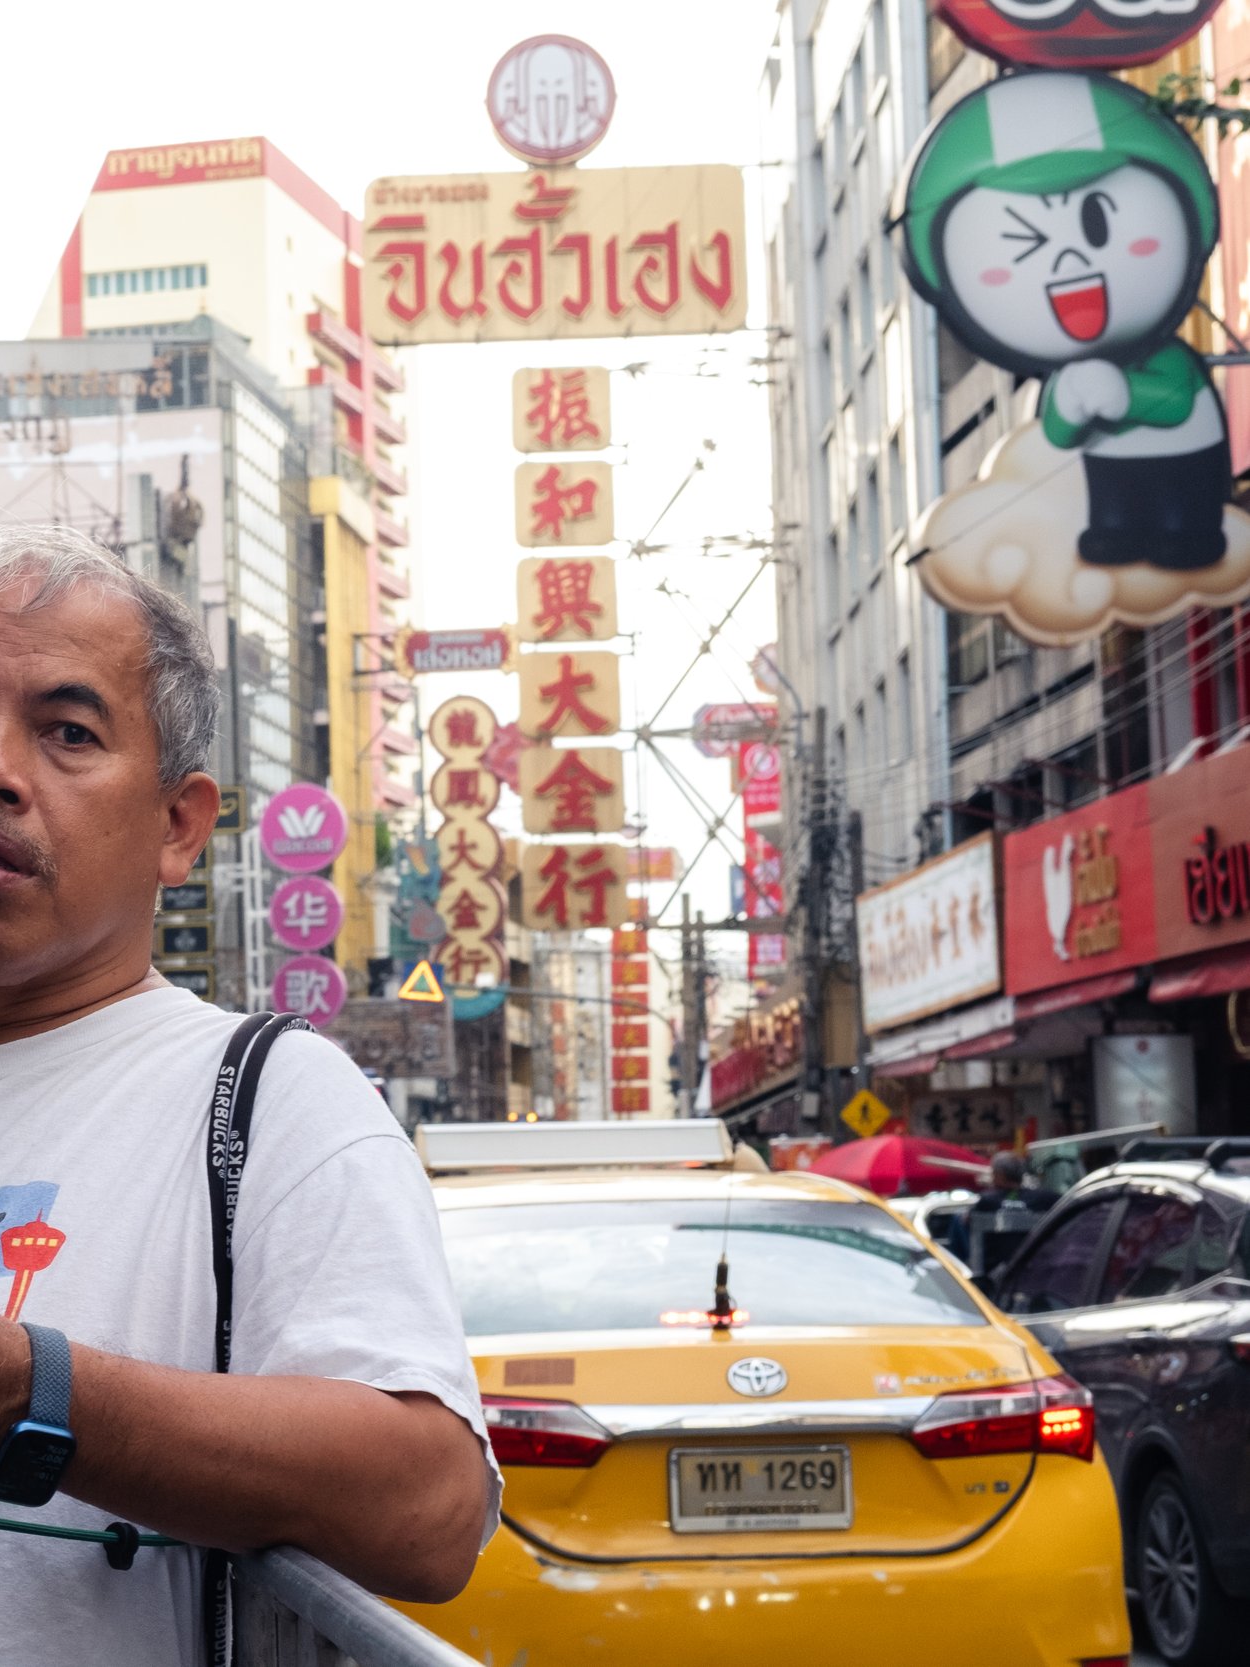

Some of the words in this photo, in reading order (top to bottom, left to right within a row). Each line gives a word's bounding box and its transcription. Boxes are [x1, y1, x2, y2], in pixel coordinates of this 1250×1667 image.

[525, 368, 618, 928] 振和興大金行
[763, 1460, 838, 1490] 1269
